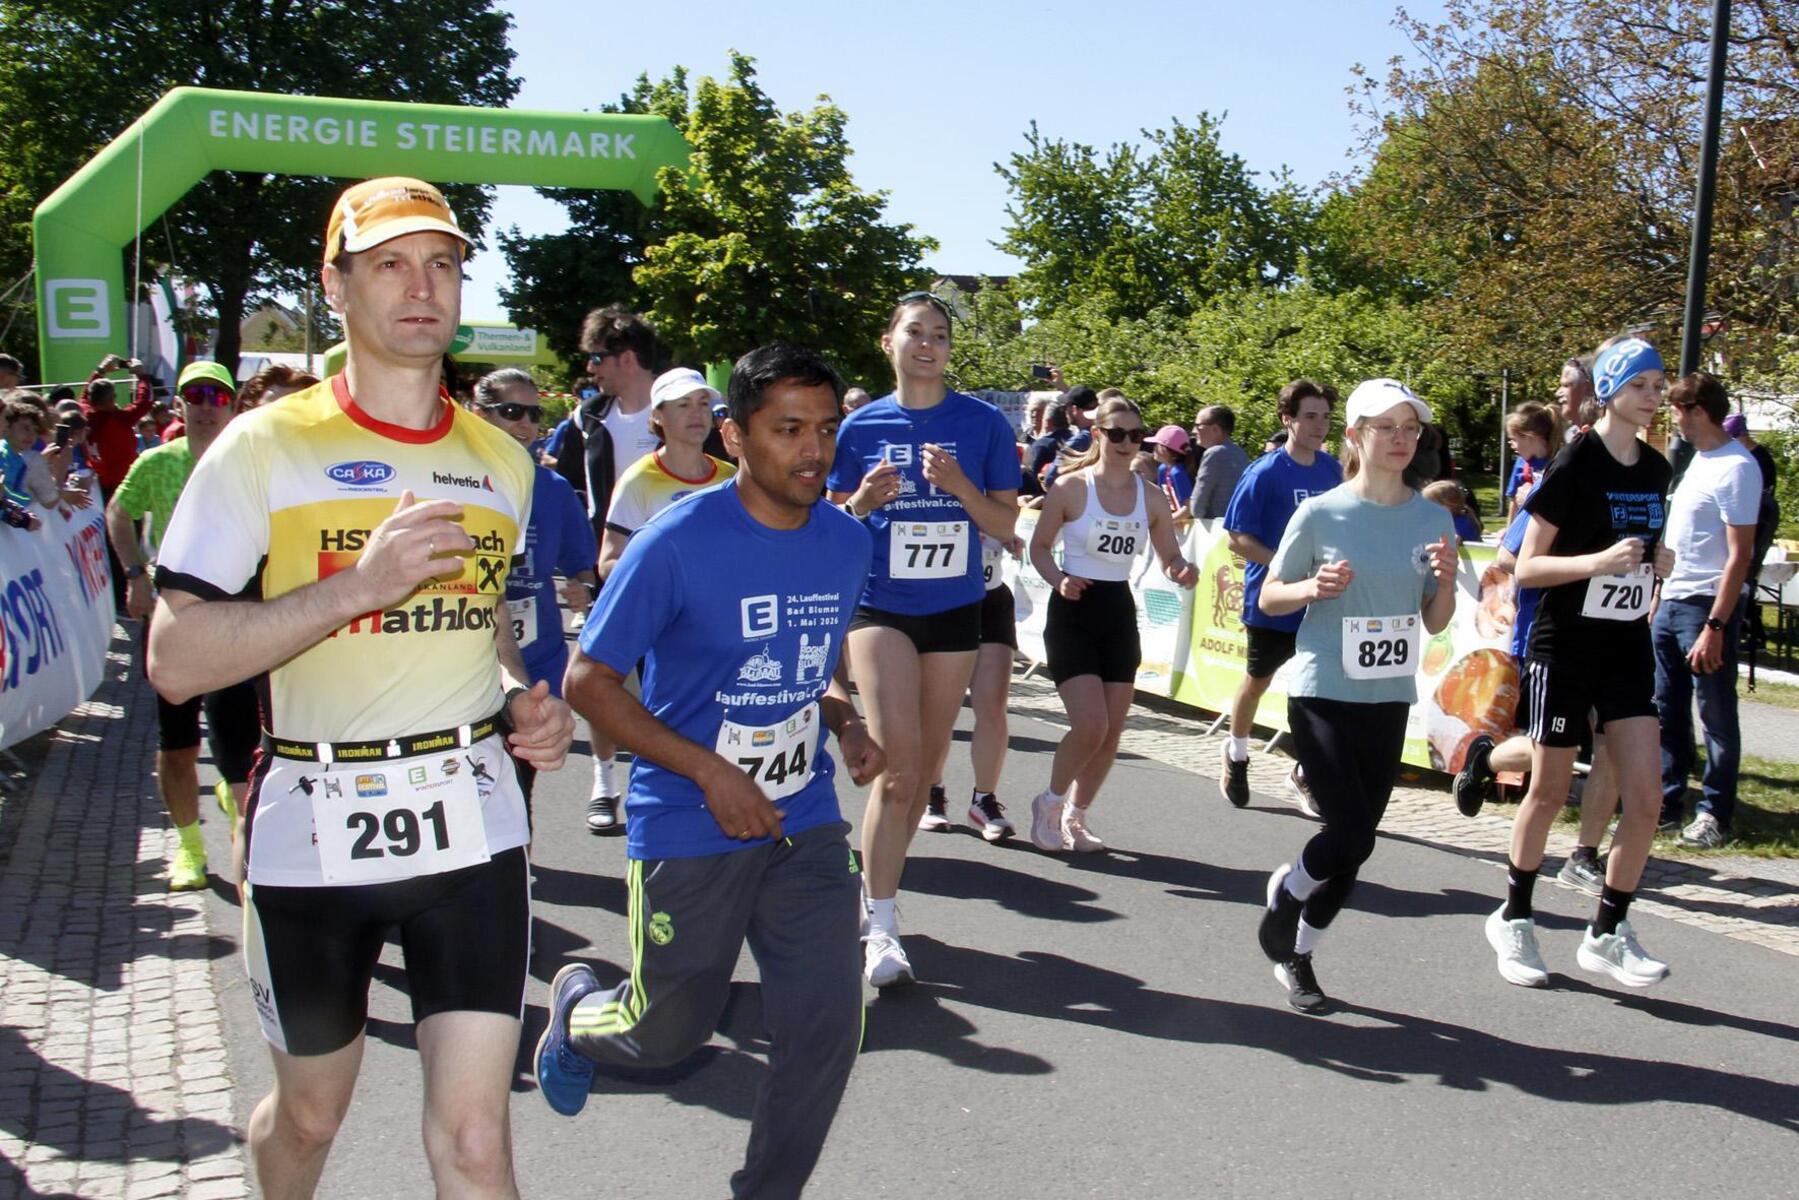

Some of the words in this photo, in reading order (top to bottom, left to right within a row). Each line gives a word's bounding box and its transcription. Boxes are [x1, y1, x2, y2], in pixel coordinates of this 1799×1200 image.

[208, 109, 379, 148] ENERGIE
[395, 121, 638, 160] STEIERMARK
[433, 471, 480, 489] helvetia
[1097, 534, 1135, 555] 208
[905, 543, 955, 568] 777
[800, 593, 839, 602] Lauffestival
[1600, 584, 1643, 609] 720
[787, 606, 804, 615] Bad
[808, 606, 839, 614] Blumau
[800, 618, 817, 626] Mai
[1201, 638, 1234, 653] ADOLF
[1359, 639, 1408, 667] 829
[1551, 717, 1565, 733] 19
[338, 745, 382, 758] IRONMAN
[412, 736, 454, 752] IRONMAN
[738, 741, 807, 785] 744
[347, 800, 450, 860] 291
